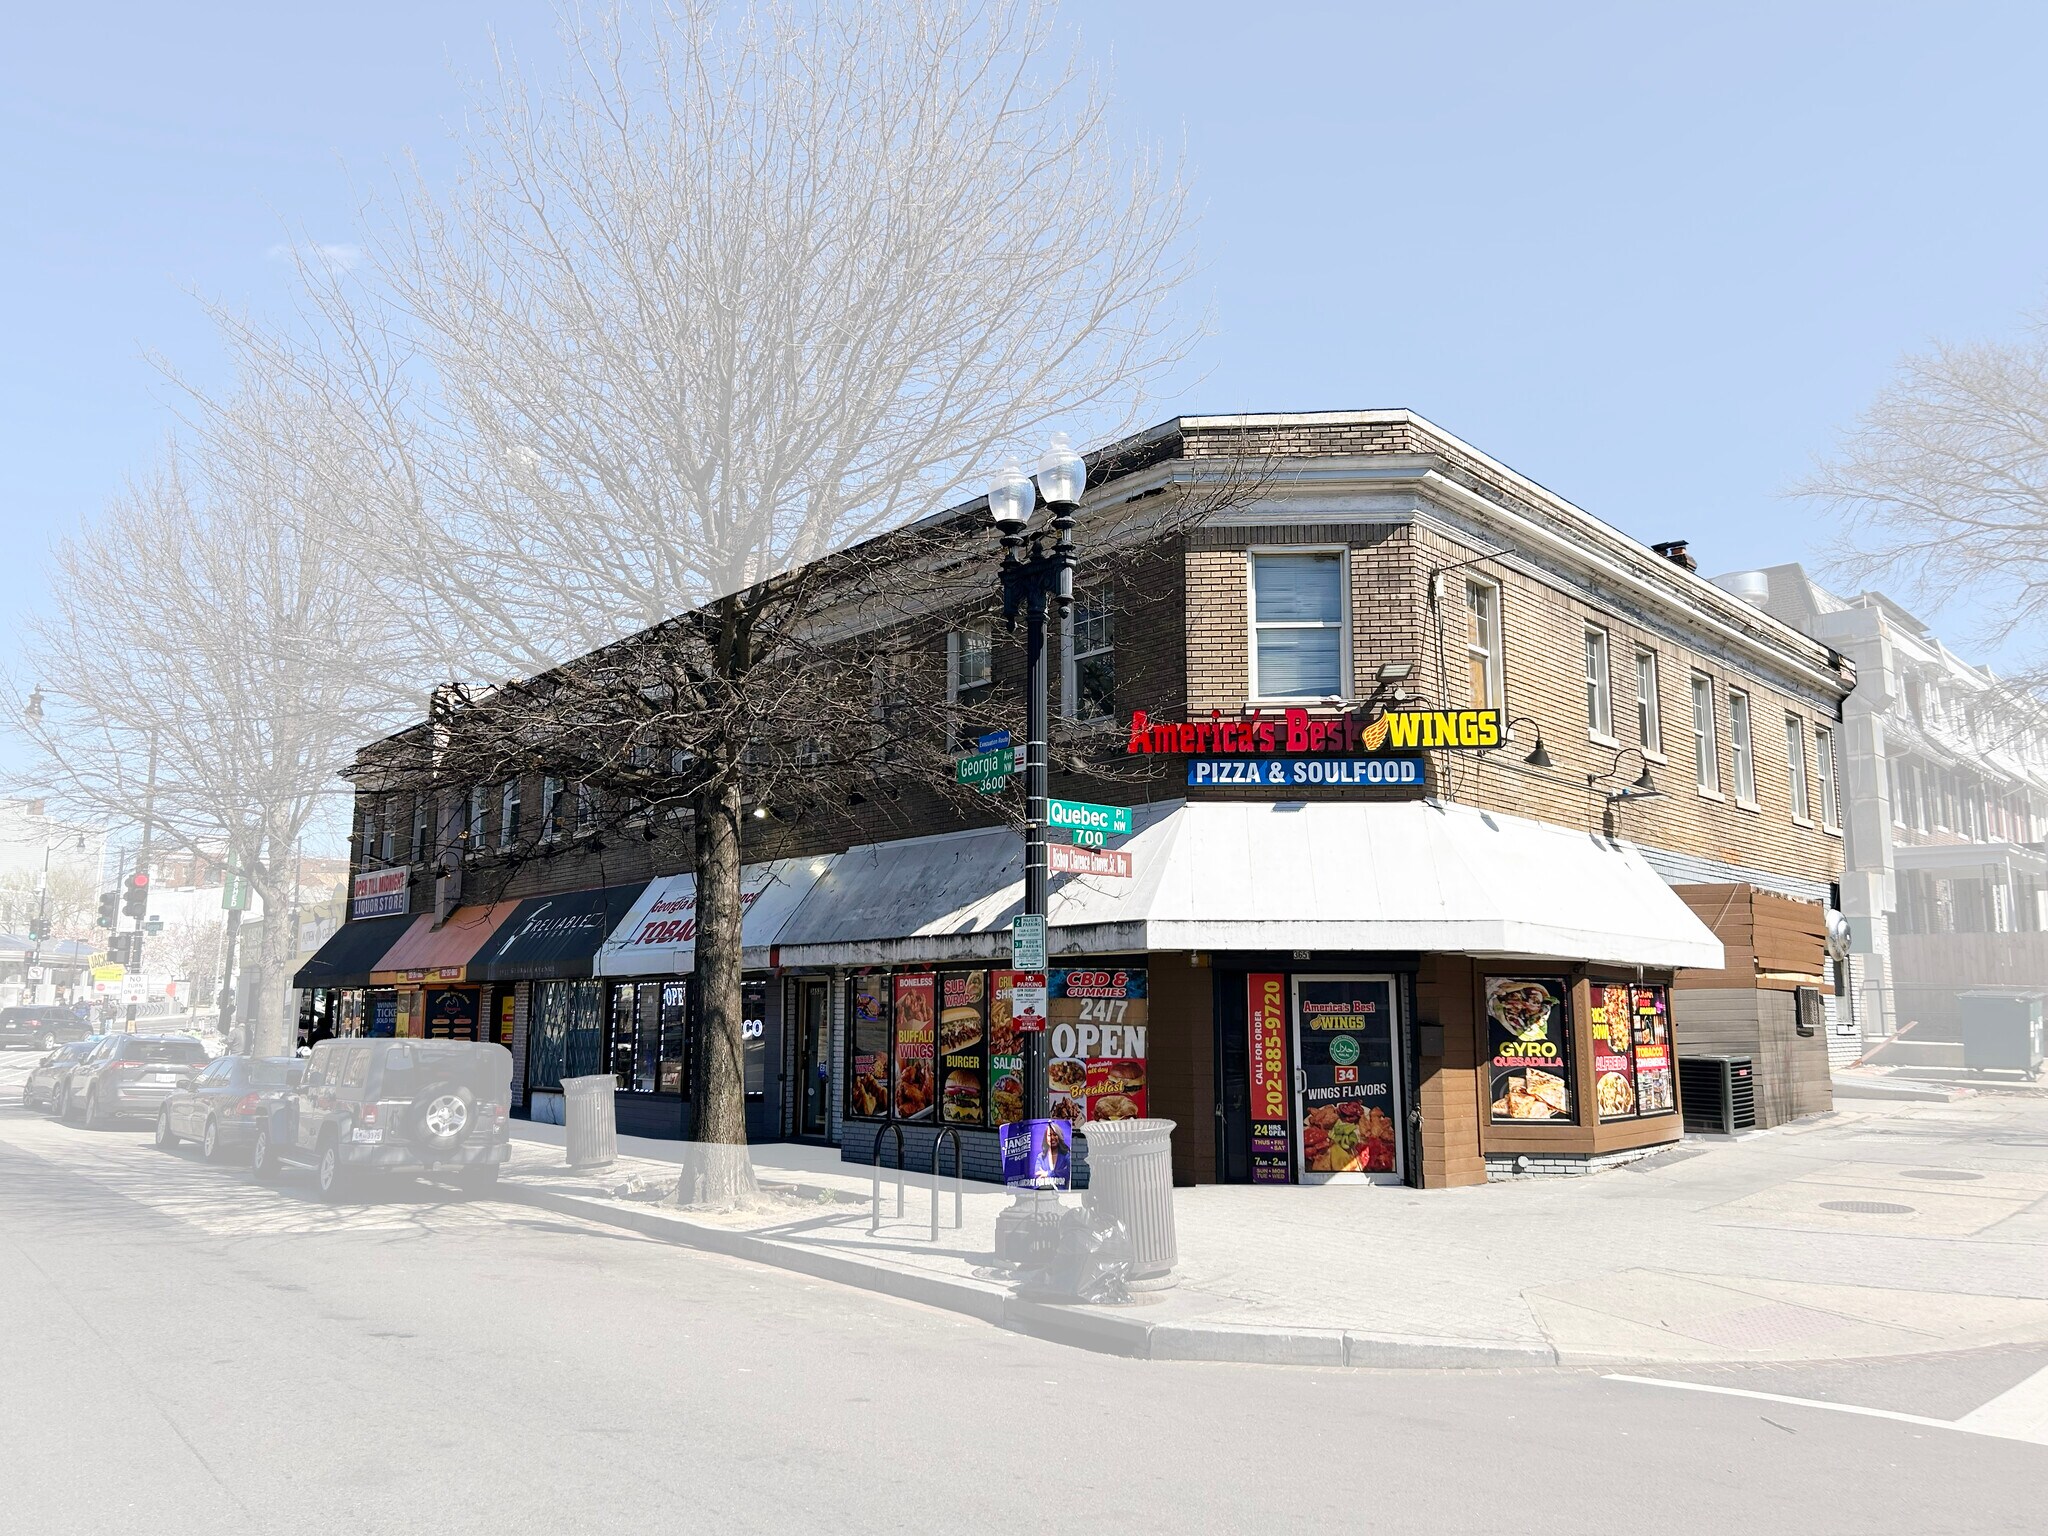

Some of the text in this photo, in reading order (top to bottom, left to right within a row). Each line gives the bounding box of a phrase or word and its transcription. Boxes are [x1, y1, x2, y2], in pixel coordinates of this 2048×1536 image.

[1128, 708, 1354, 753] America's Best
[1388, 711, 1499, 747] WINGS
[961, 751, 1013, 780] Georgia Ave
[1004, 762, 1013, 772] NW
[1196, 761, 1416, 784] PIZZA & SOULFOOD
[980, 776, 1004, 792] 3600
[1051, 802, 1109, 828] Quebec
[1114, 820, 1126, 832] NW
[1076, 830, 1104, 845] 700
[1052, 847, 1069, 872] Bishop
[1070, 849, 1090, 870] Clarence
[1117, 854, 1127, 878] Way
[355, 879, 368, 897] OPEN
[354, 894, 402, 914] LIQUOR STORE
[652, 898, 686, 914] Georgia
[531, 913, 592, 932] RELIABLE
[634, 918, 696, 945] TOBAC
[900, 978, 933, 987] BONELESS
[944, 980, 965, 993] SUB
[1067, 972, 1129, 987] CBD &
[1067, 987, 1127, 998] GUMMIES
[1079, 998, 1128, 1023] 24/7
[1303, 1000, 1376, 1013] America's Best
[1320, 1015, 1364, 1029] WINGS
[899, 1030, 934, 1043] BUFFALO
[1051, 1022, 1147, 1059] OPEN
[900, 1044, 934, 1059] WINGS
[1254, 1010, 1264, 1086] CALL FOR ORDER
[1264, 981, 1283, 1117] 202-885-9720
[1500, 1042, 1557, 1058] GYRO
[1636, 1046, 1664, 1058] TOBACCO
[946, 1056, 980, 1068] BURGER
[993, 1056, 1022, 1070] SALAD
[1493, 1056, 1564, 1067] QUESADILLA
[1596, 1056, 1628, 1072] ALFREDO
[1088, 1066, 1097, 1074] all
[1338, 1069, 1354, 1080] 34
[1070, 1080, 1125, 1098] Breakfast
[1308, 1083, 1387, 1100] WINGS FLAVORS
[1254, 1124, 1268, 1136] 24
[1272, 1157, 1286, 1166] 2AM
